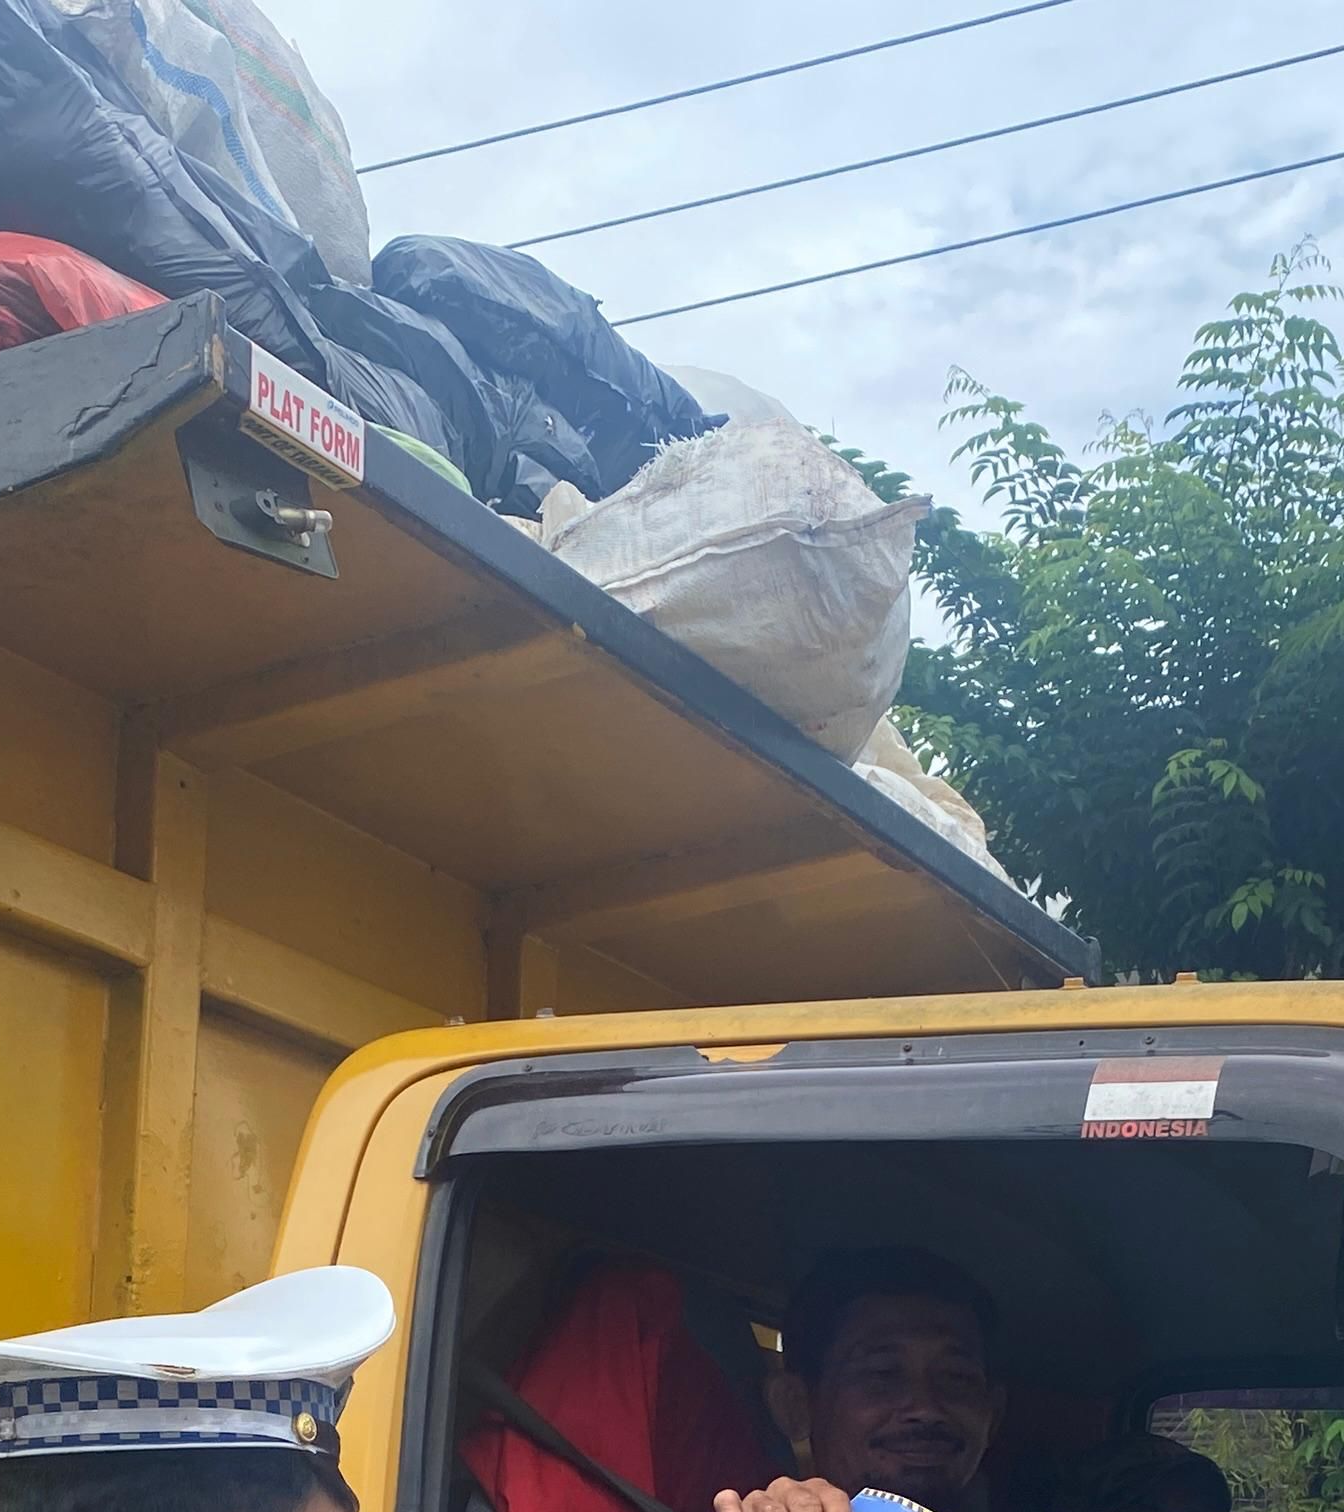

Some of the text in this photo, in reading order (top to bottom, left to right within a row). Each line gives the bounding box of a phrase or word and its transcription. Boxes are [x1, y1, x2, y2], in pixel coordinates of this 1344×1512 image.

[258, 371, 360, 473] PLAT FORM
[1080, 1120, 1209, 1139] INDONESIA
